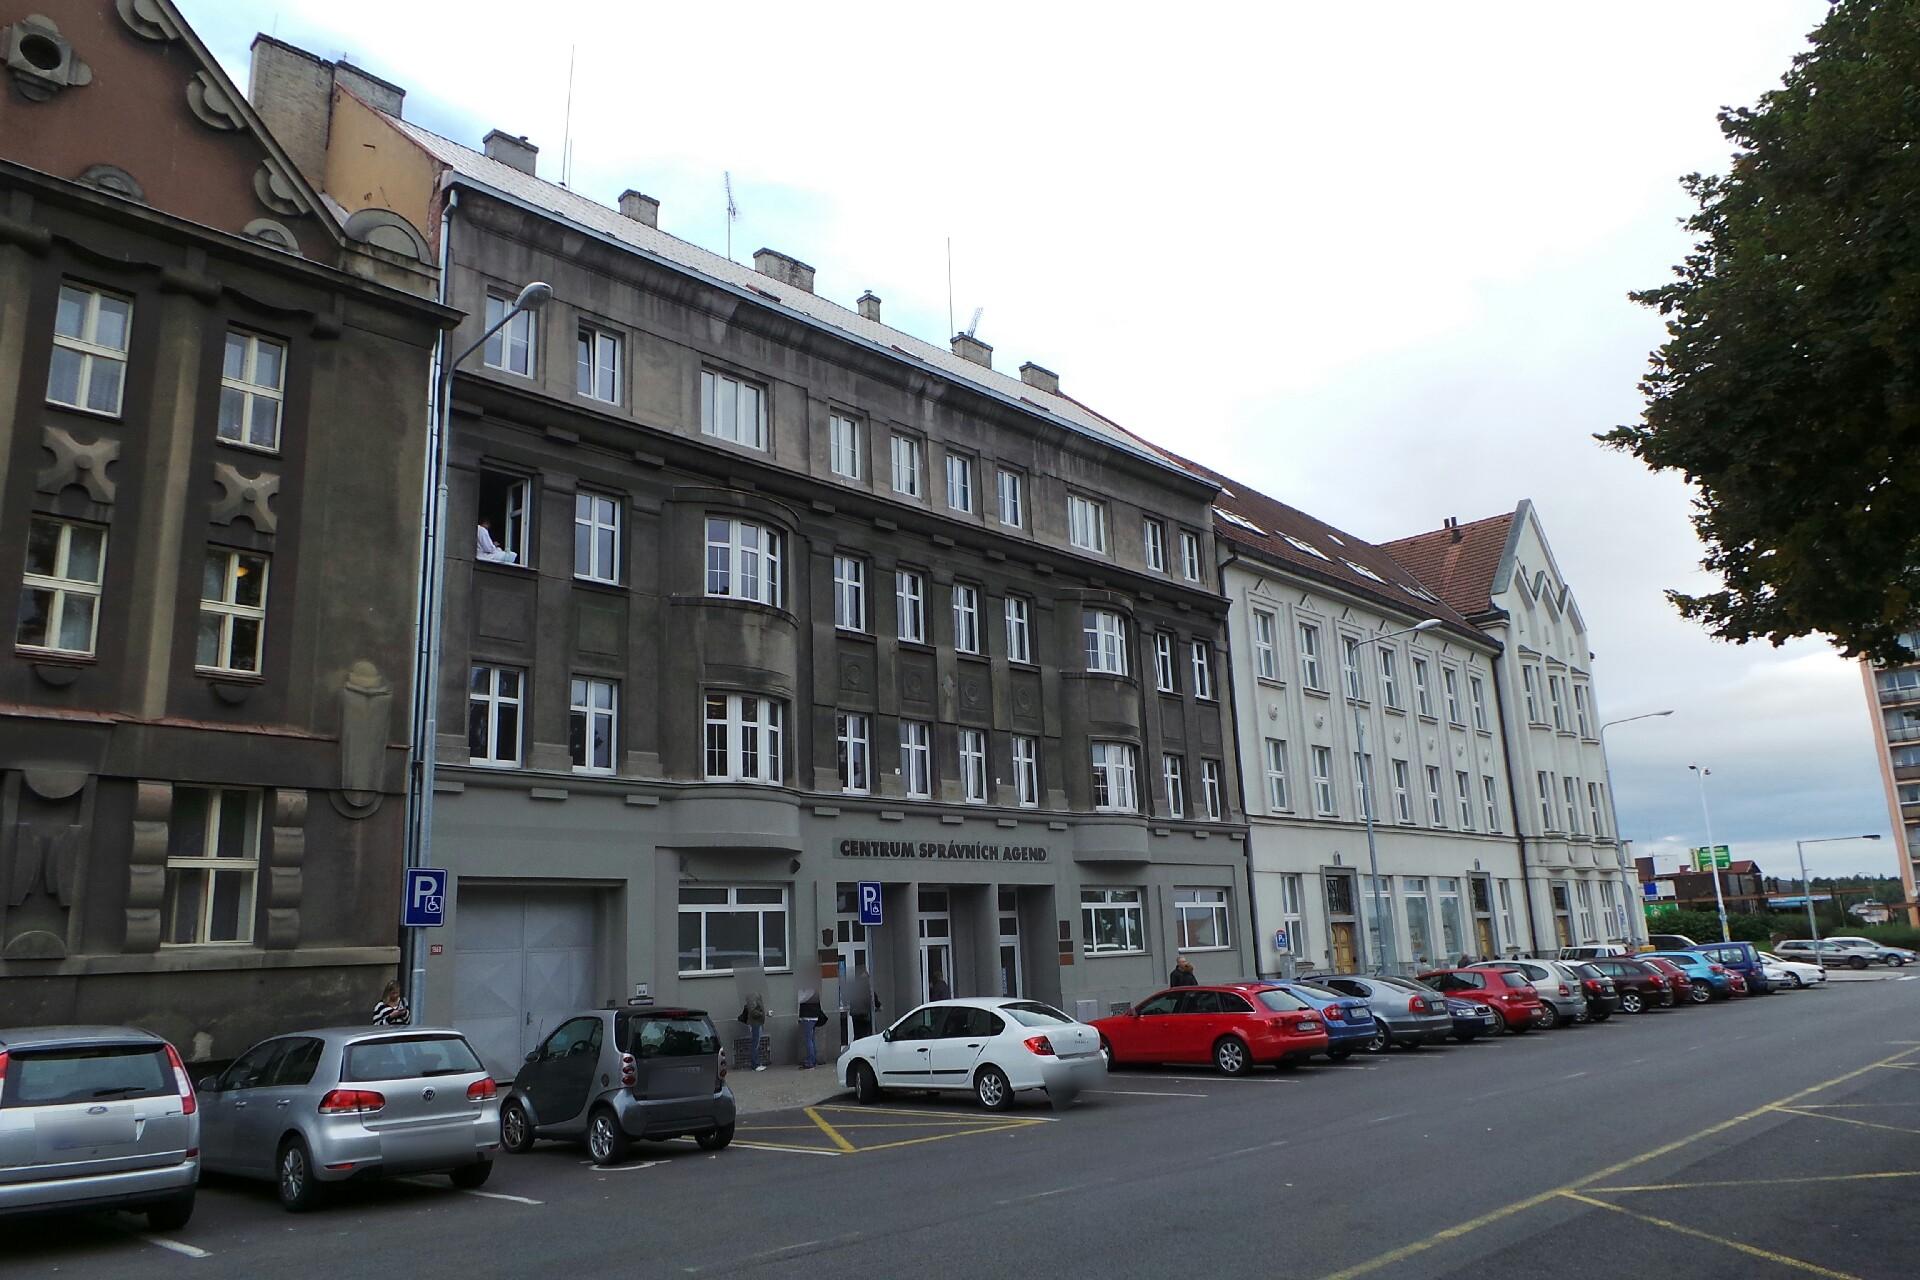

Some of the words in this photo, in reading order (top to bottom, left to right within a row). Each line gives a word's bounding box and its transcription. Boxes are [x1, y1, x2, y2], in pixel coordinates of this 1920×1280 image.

[840, 840, 915, 858] CENTRUM
[919, 840, 999, 861] SPRÁVNÍCH
[1003, 847, 1047, 861] AGEND
[414, 876, 438, 908] P
[863, 886, 877, 912] P
